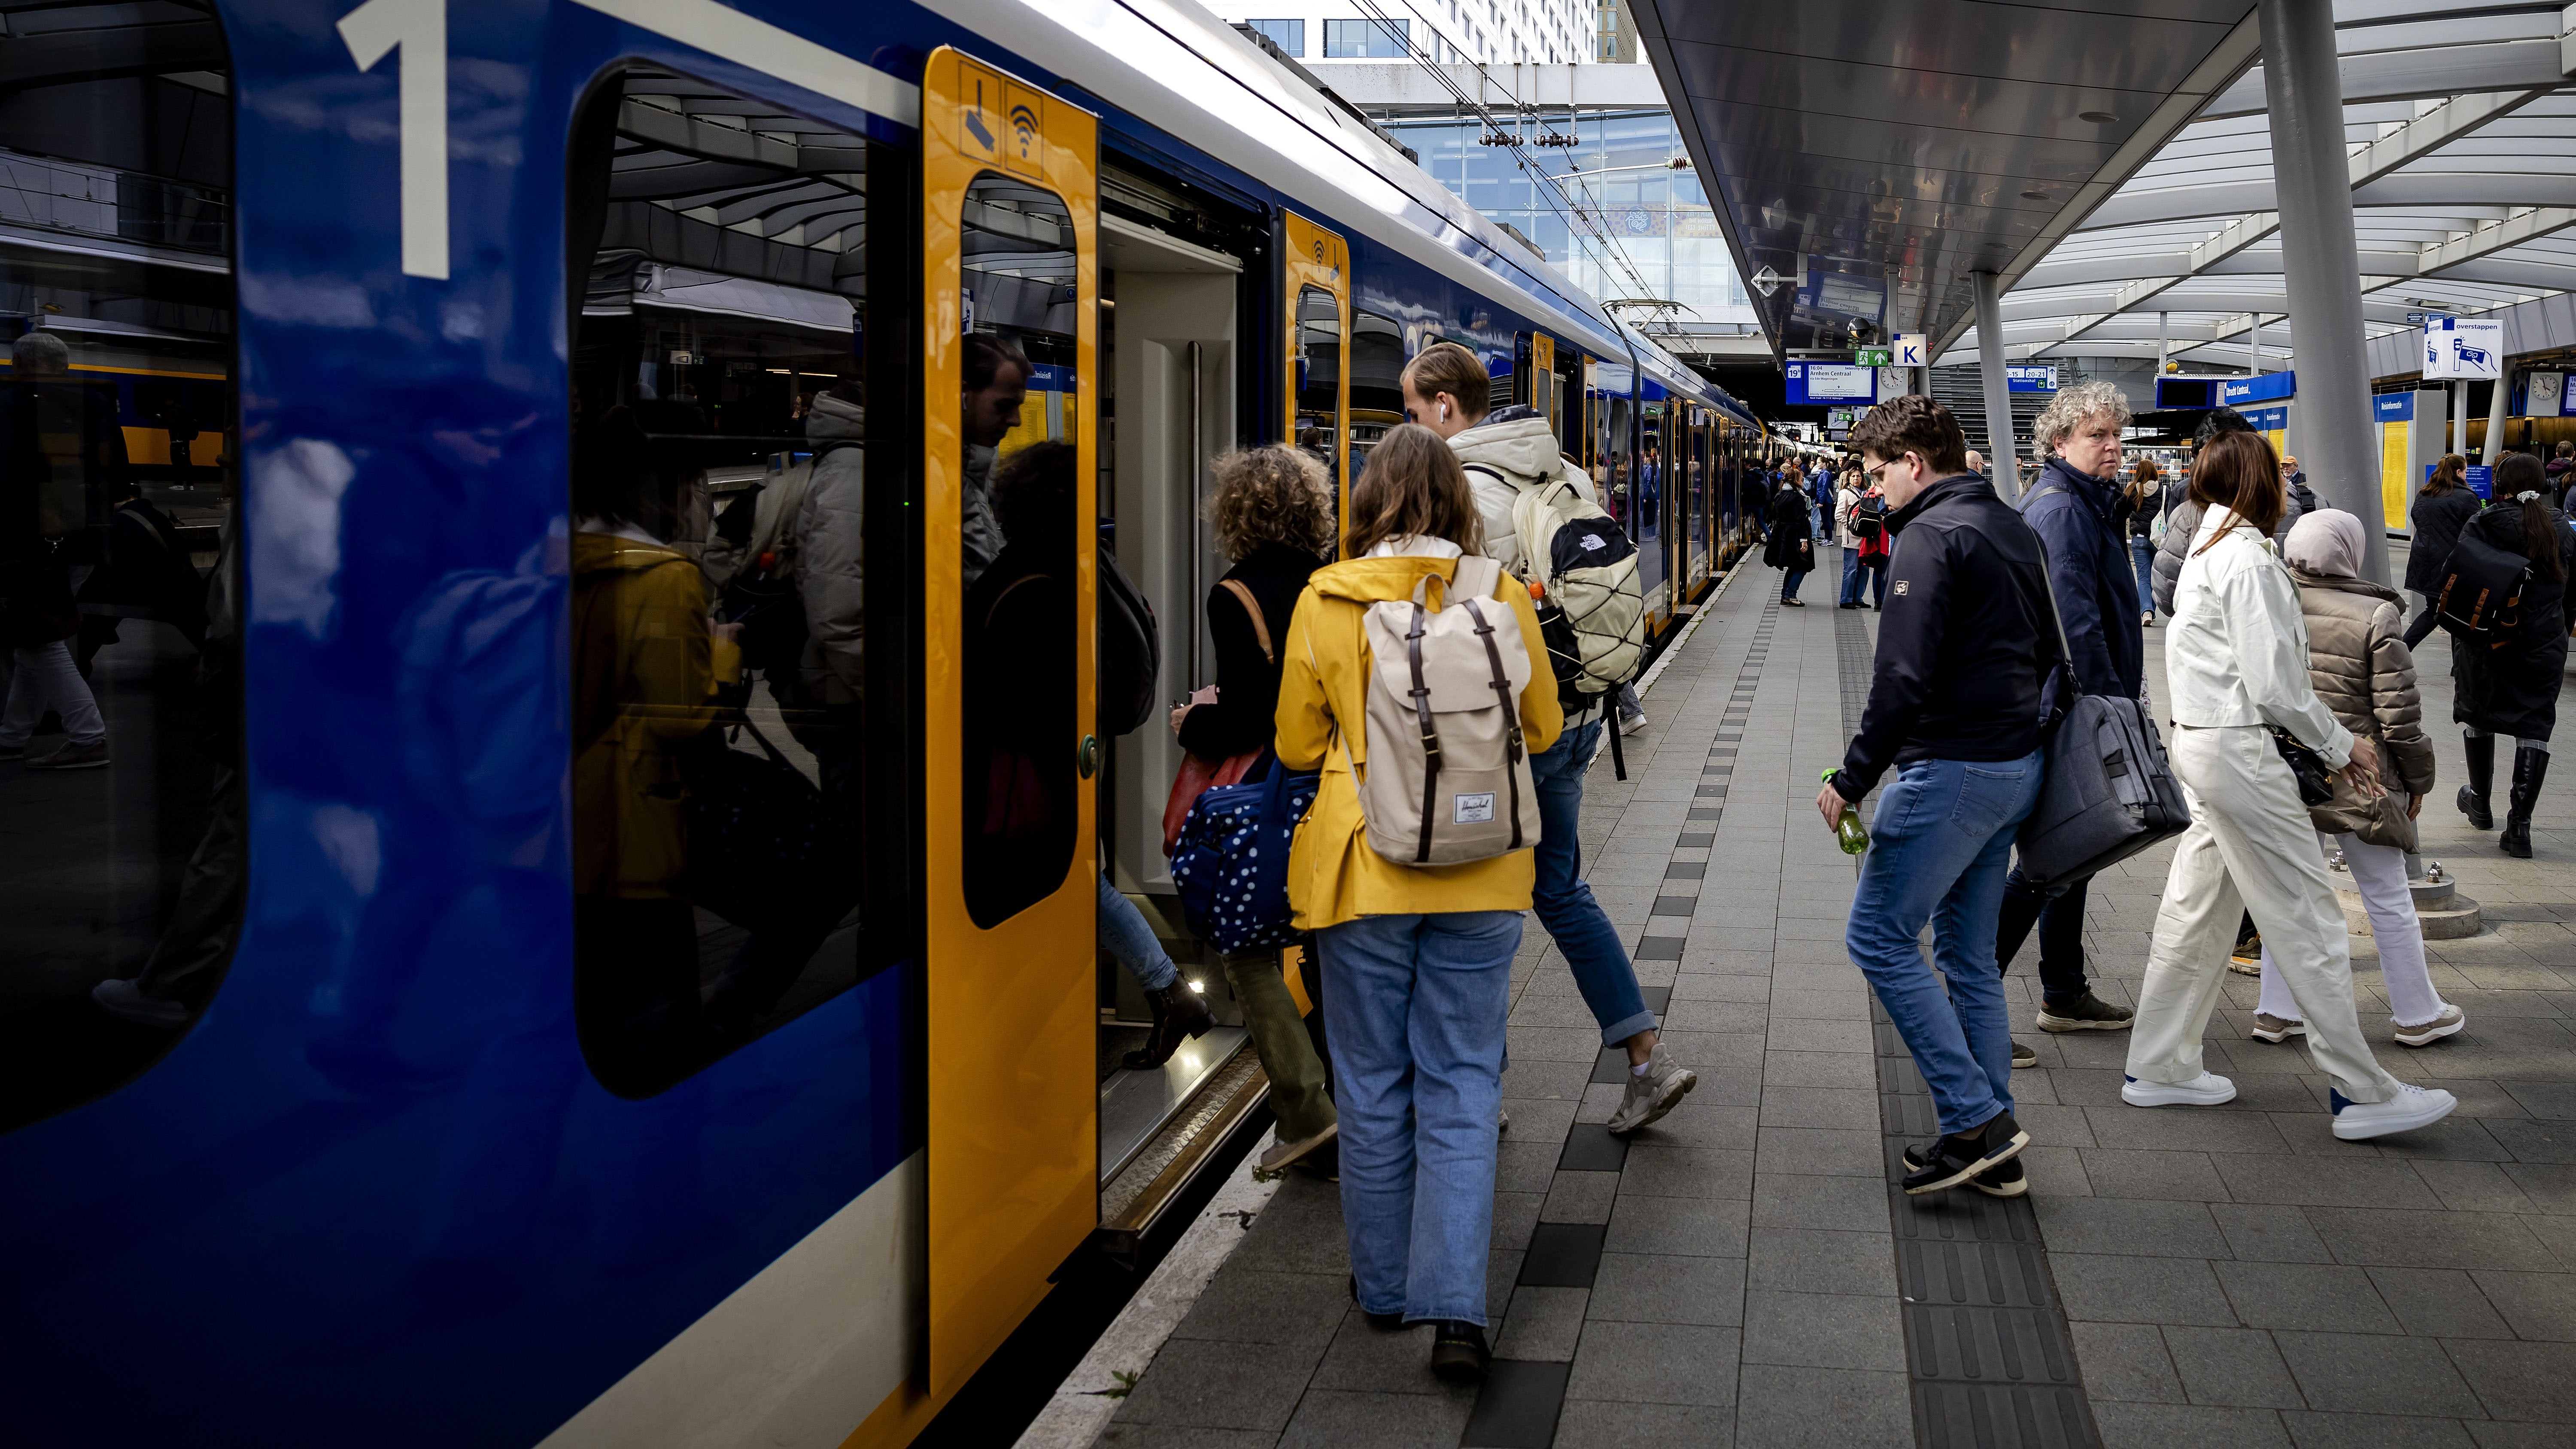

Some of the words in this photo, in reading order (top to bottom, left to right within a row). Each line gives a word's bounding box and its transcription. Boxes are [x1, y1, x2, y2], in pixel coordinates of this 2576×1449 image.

[336, 0, 450, 280] 1
[1904, 346, 1918, 363] K
[2226, 386, 2236, 397] Utrecht
[2236, 383, 2249, 395] Centraal
[2381, 400, 2402, 410] Reisinformatie
[1859, 412, 1865, 420] L
